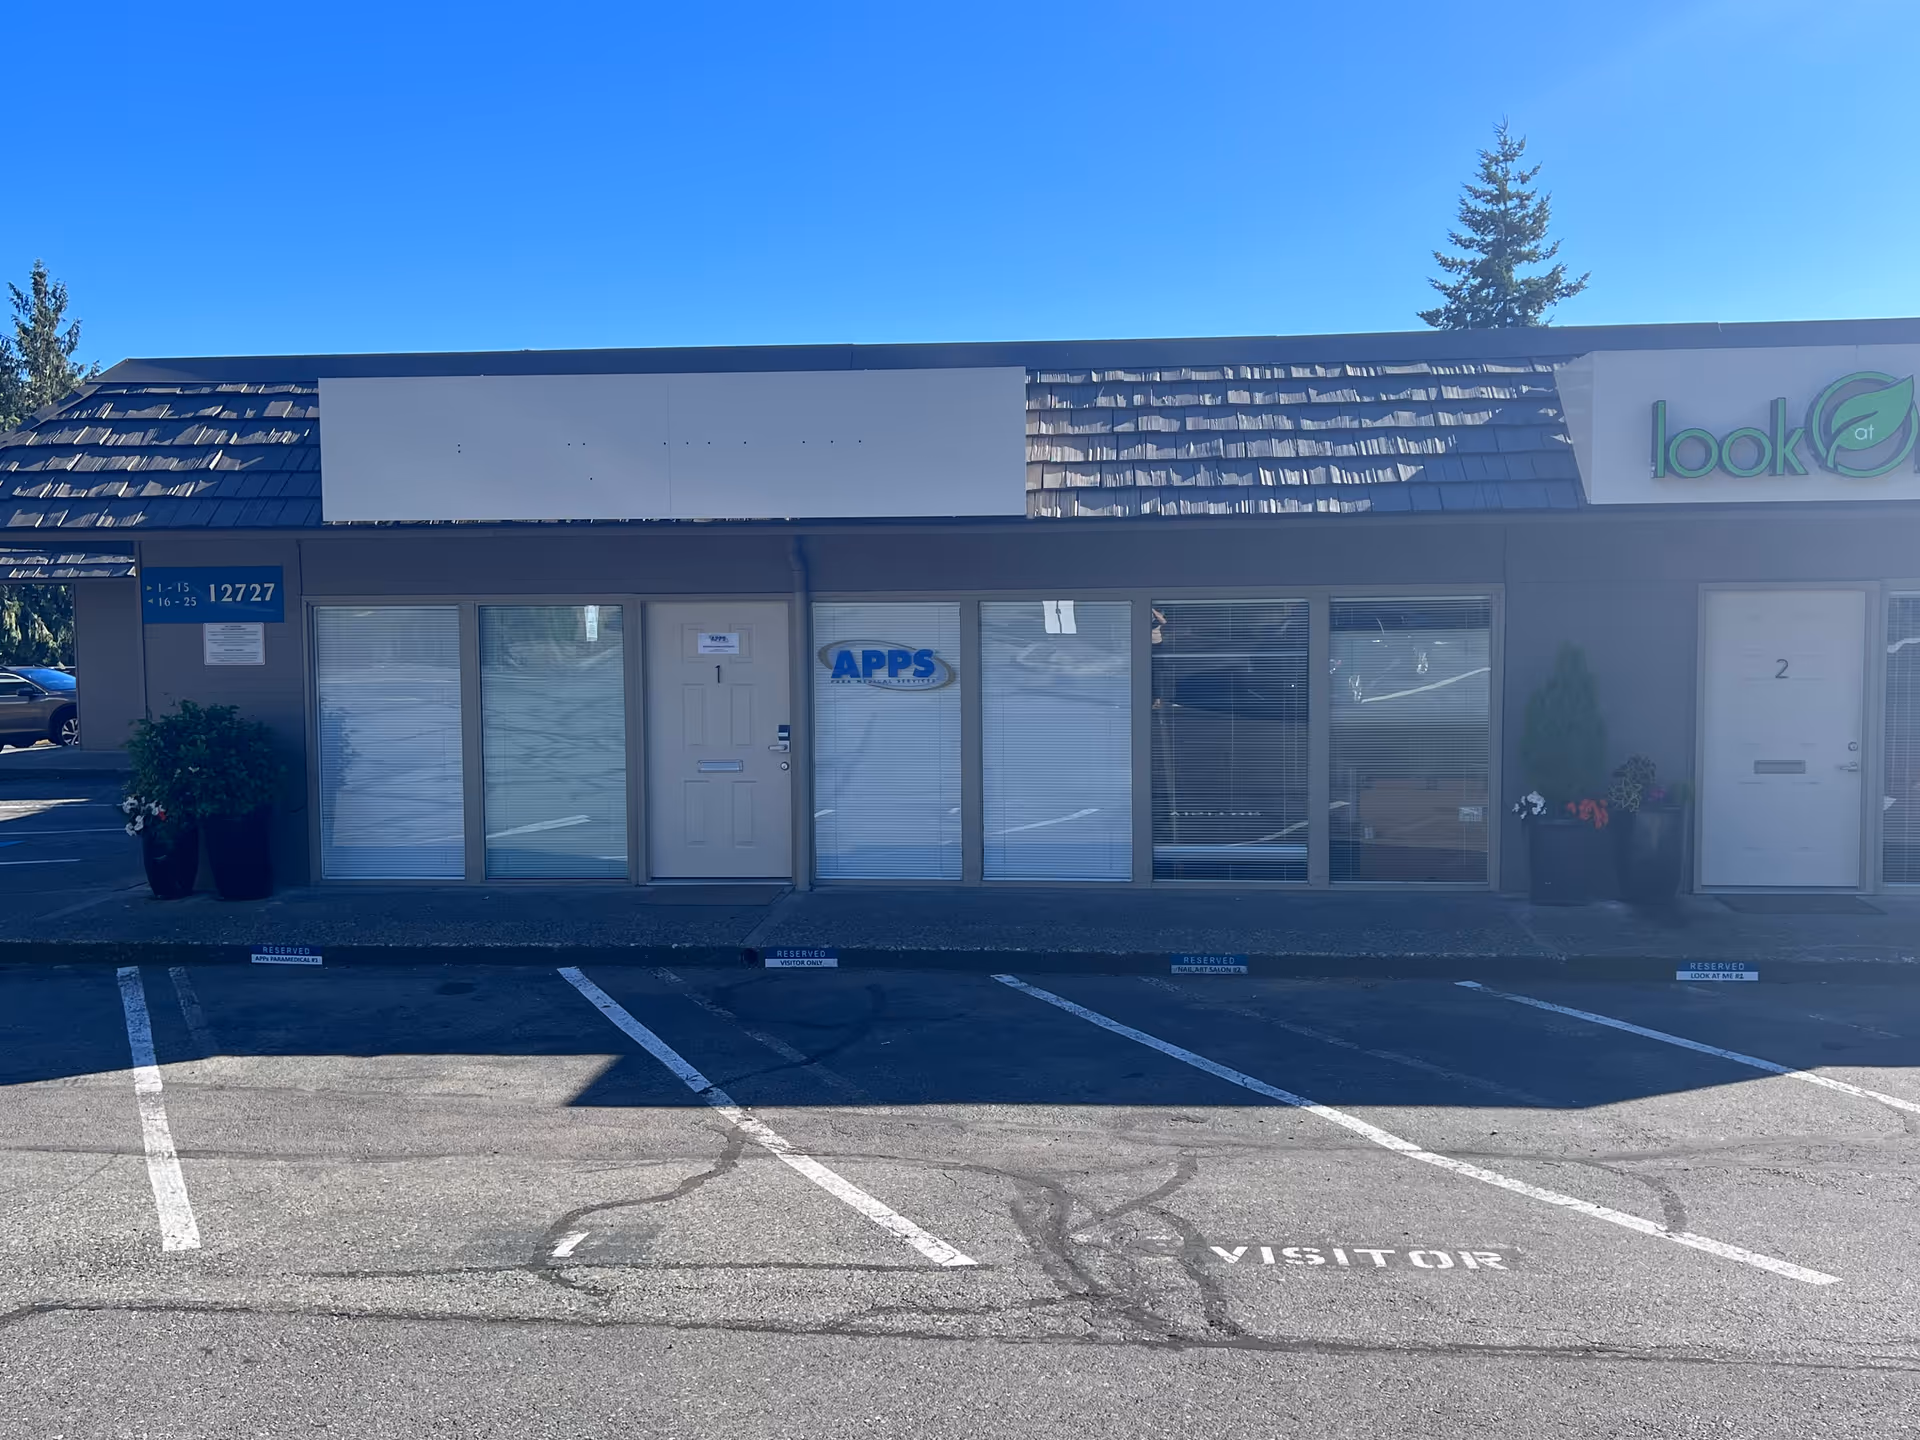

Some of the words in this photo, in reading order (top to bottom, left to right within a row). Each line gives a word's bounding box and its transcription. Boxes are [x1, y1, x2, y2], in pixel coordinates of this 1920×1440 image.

[1651, 397, 1809, 478] look
[1854, 424, 1874, 441] at
[177, 583, 190, 592] 15
[209, 583, 275, 602] 12727
[158, 597, 171, 607] 16
[184, 597, 197, 607] 25
[831, 649, 936, 679] APPS
[1774, 658, 1790, 679] 2
[714, 664, 721, 684] 1
[262, 946, 311, 955] RESERVED
[776, 950, 826, 958] RESERVED
[1183, 956, 1235, 965] RESERVED
[1690, 962, 1745, 971] RESERVED
[1209, 1246, 1509, 1270] VISITOR
